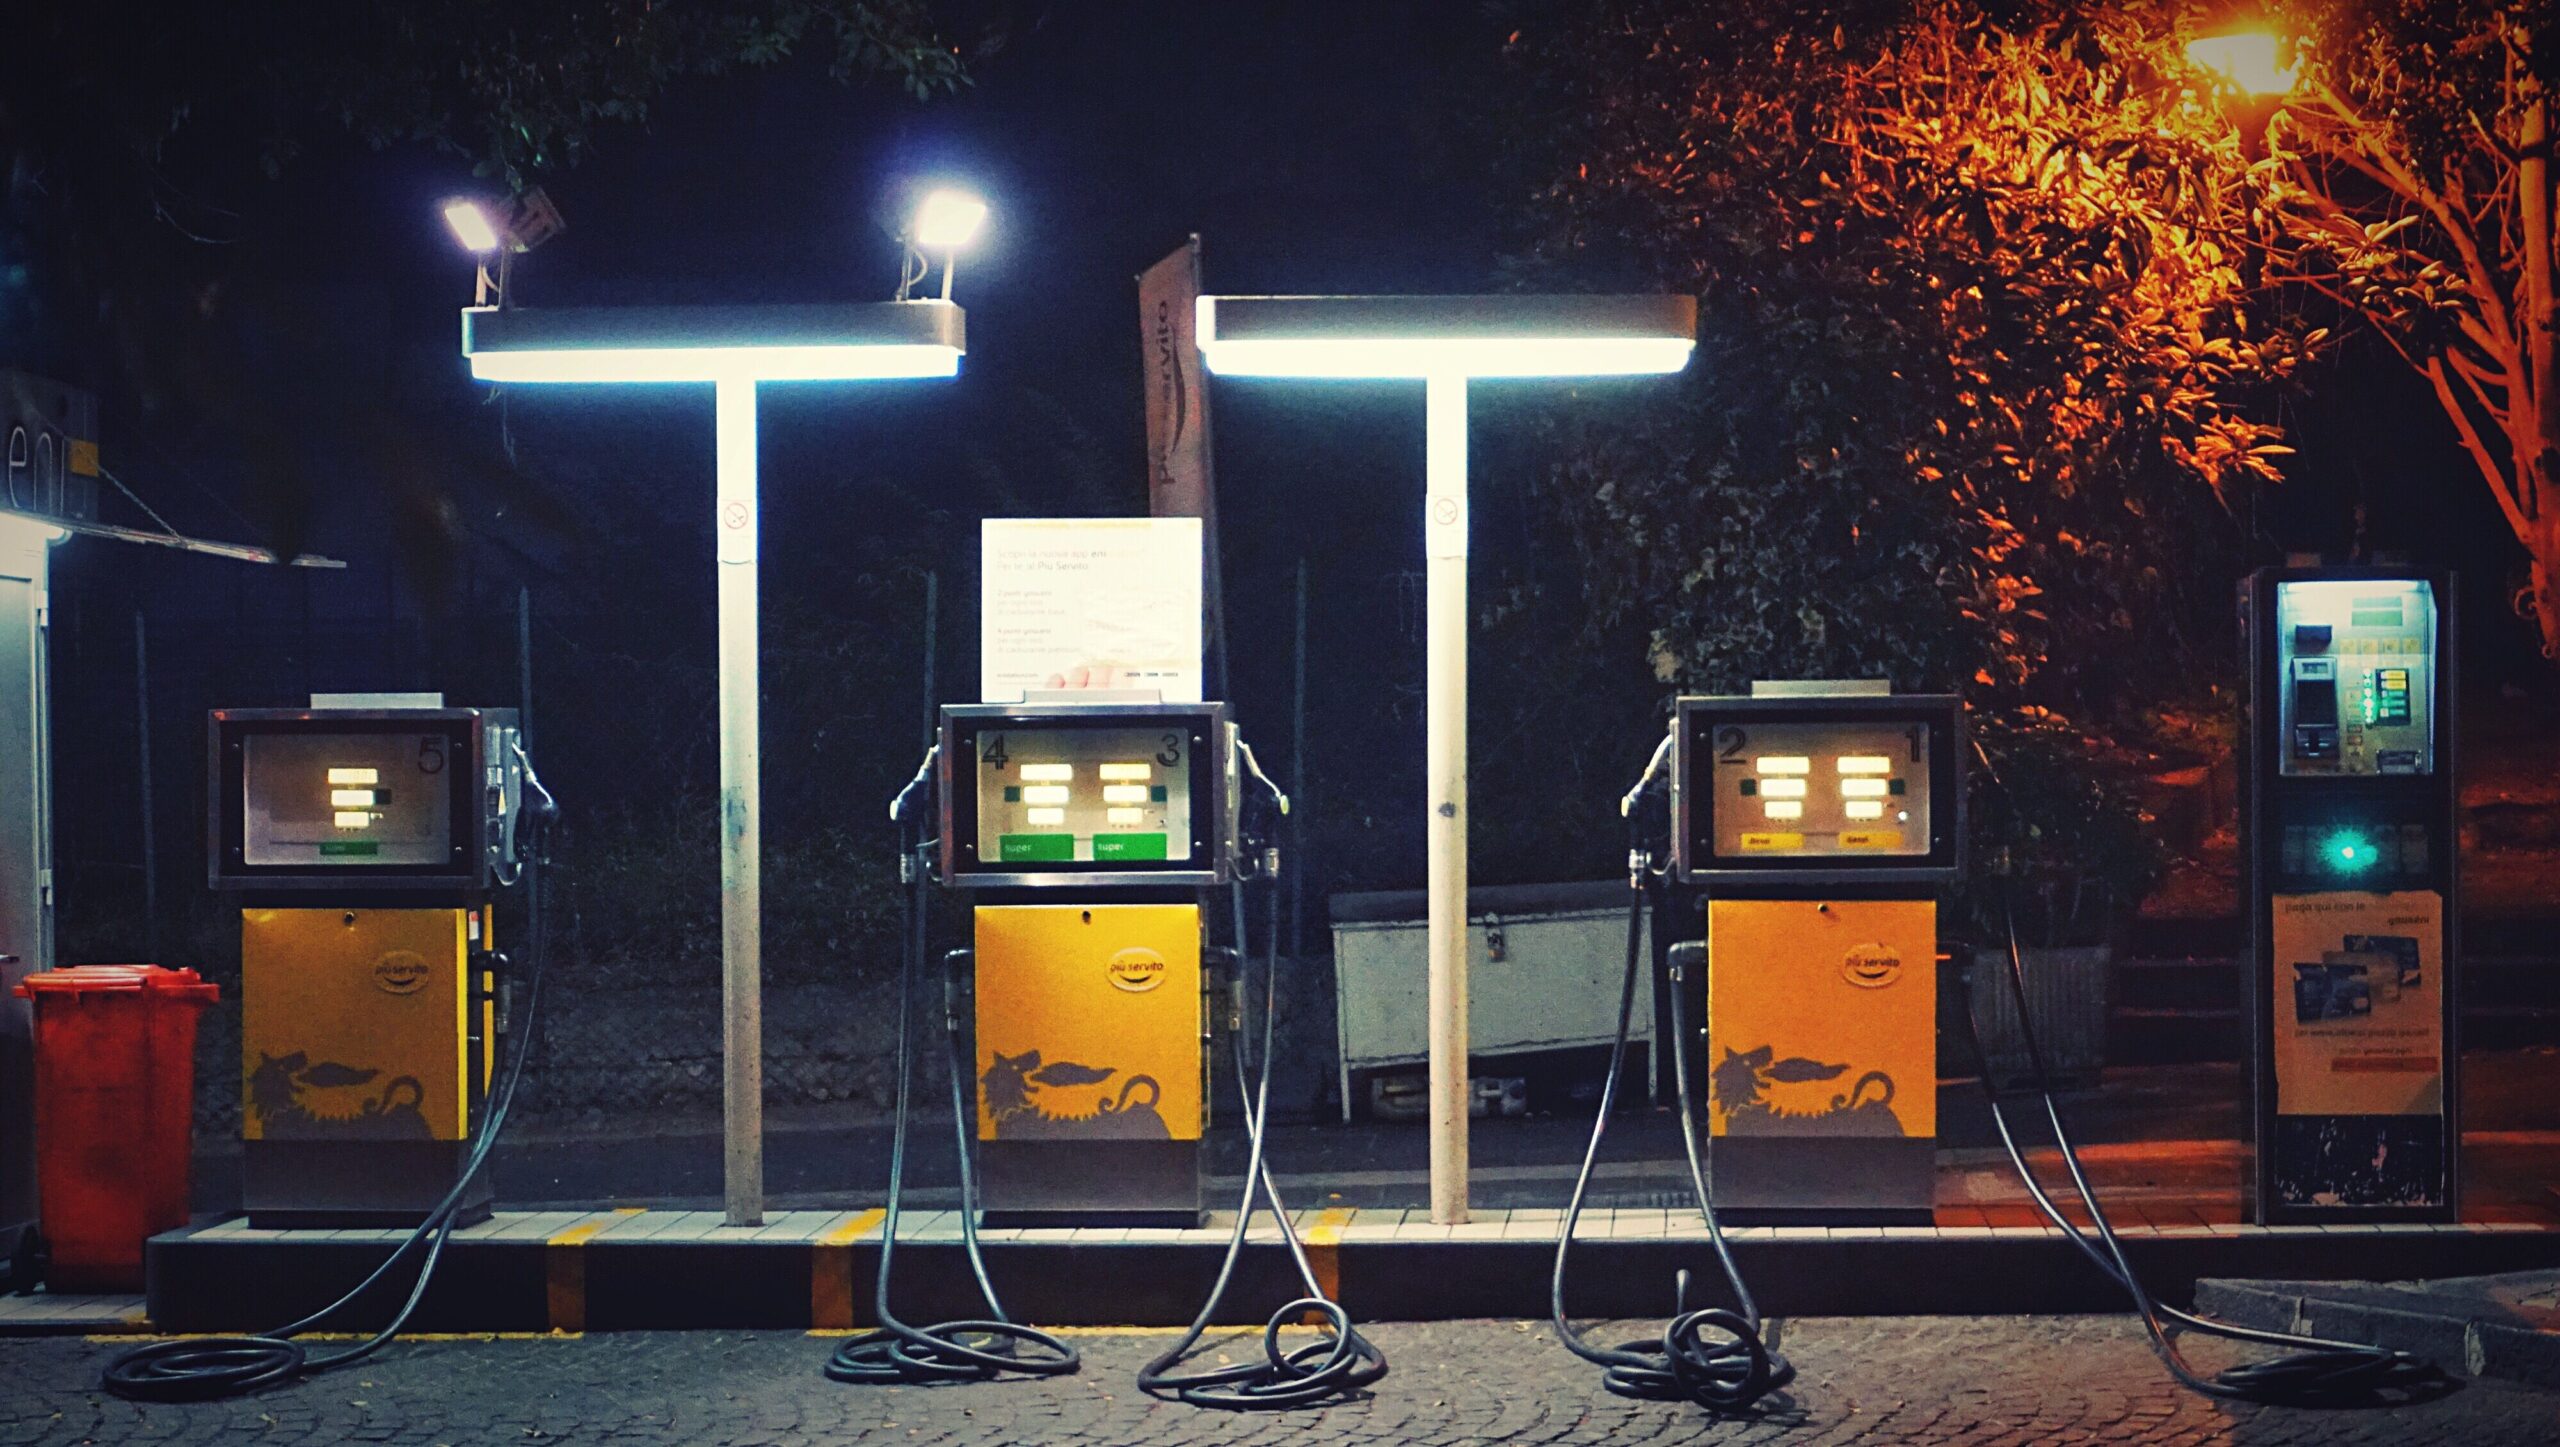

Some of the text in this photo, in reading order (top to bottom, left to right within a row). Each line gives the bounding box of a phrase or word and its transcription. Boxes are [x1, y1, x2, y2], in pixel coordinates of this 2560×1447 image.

[1091, 550, 1107, 558] eni
[1056, 561, 1089, 570] Servito
[1718, 726, 1746, 764] 2
[1905, 726, 1921, 762] 1
[417, 736, 444, 774] 5
[981, 734, 1009, 770] 4
[1156, 733, 1181, 767] 3
[1004, 844, 1032, 853] super
[1097, 843, 1124, 852] super
[1128, 961, 1164, 972] servito
[1864, 955, 1900, 967] servito
[393, 963, 429, 974] servito
